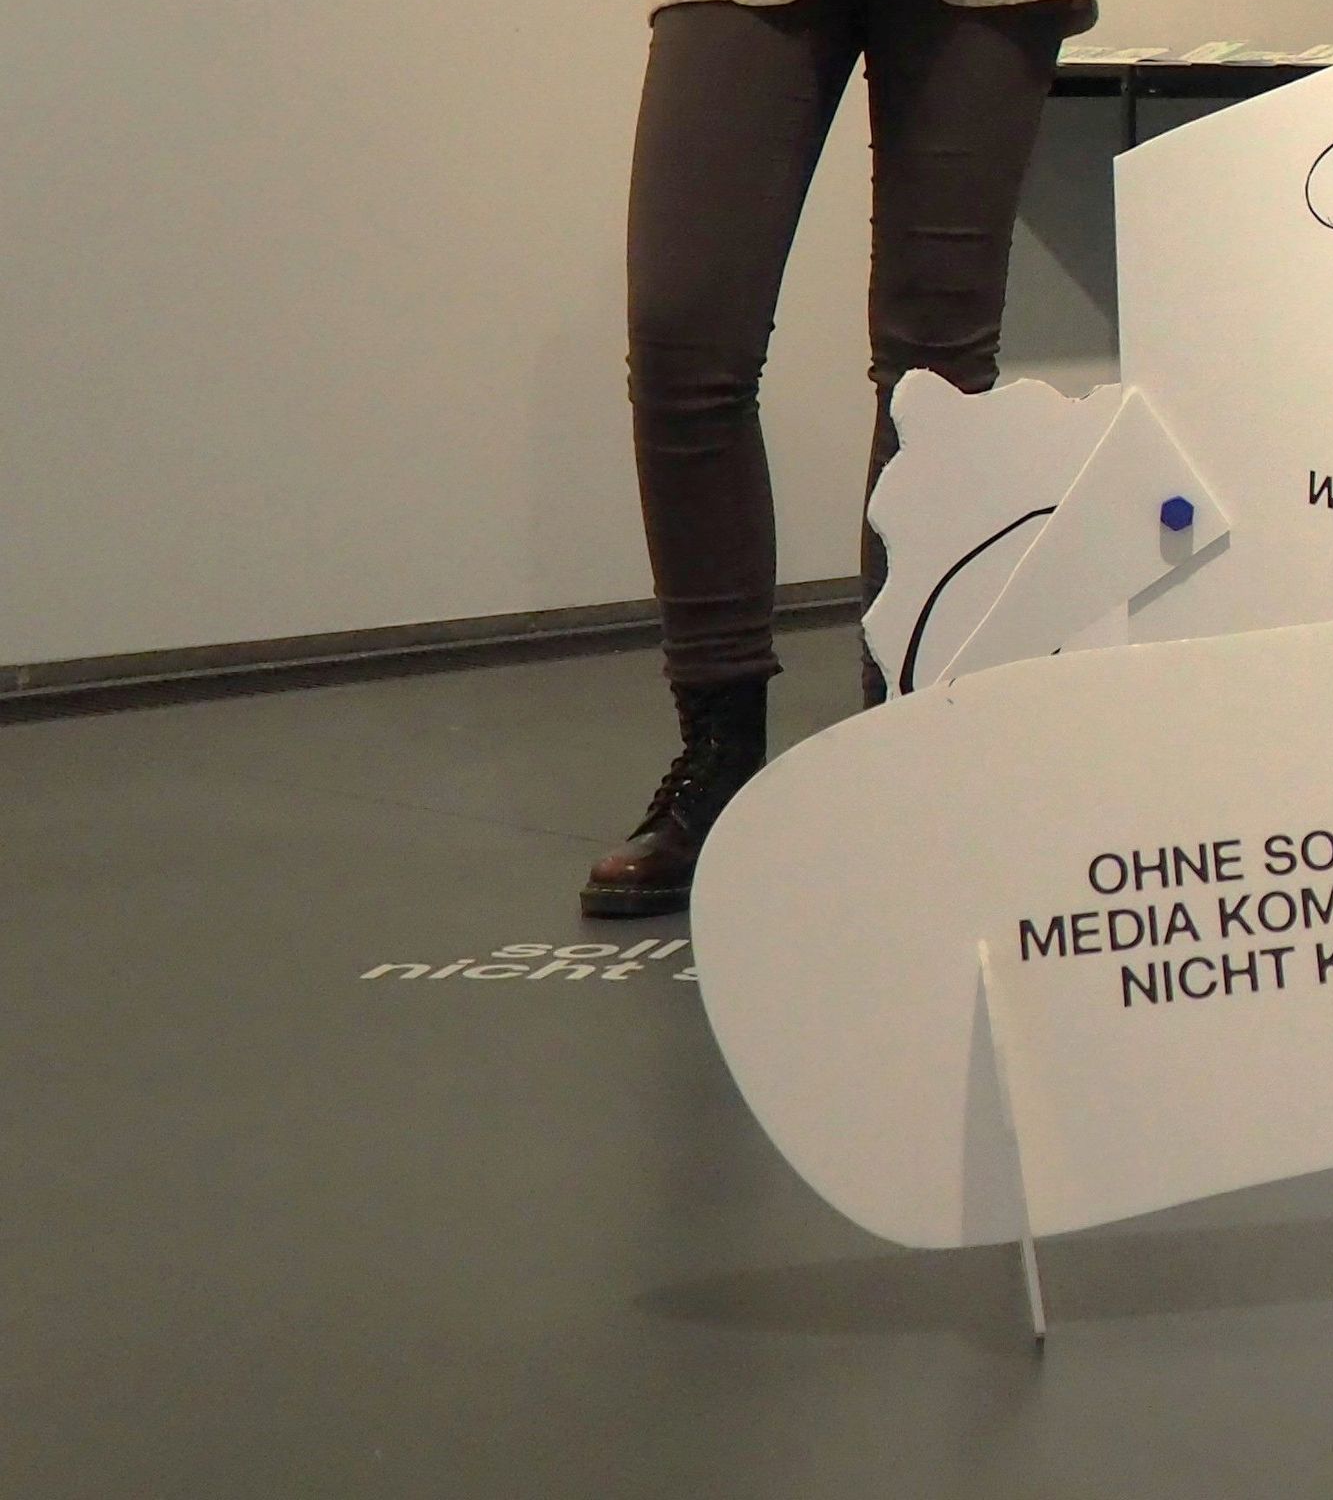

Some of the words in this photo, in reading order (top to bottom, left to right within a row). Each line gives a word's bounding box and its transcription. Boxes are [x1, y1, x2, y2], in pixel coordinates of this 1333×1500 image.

[1087, 838, 1245, 896] OHNE
[490, 938, 691, 960] soll
[1018, 901, 1201, 962] MEDIA
[359, 958, 646, 981] nicht
[1120, 946, 1296, 1008] NICHT
